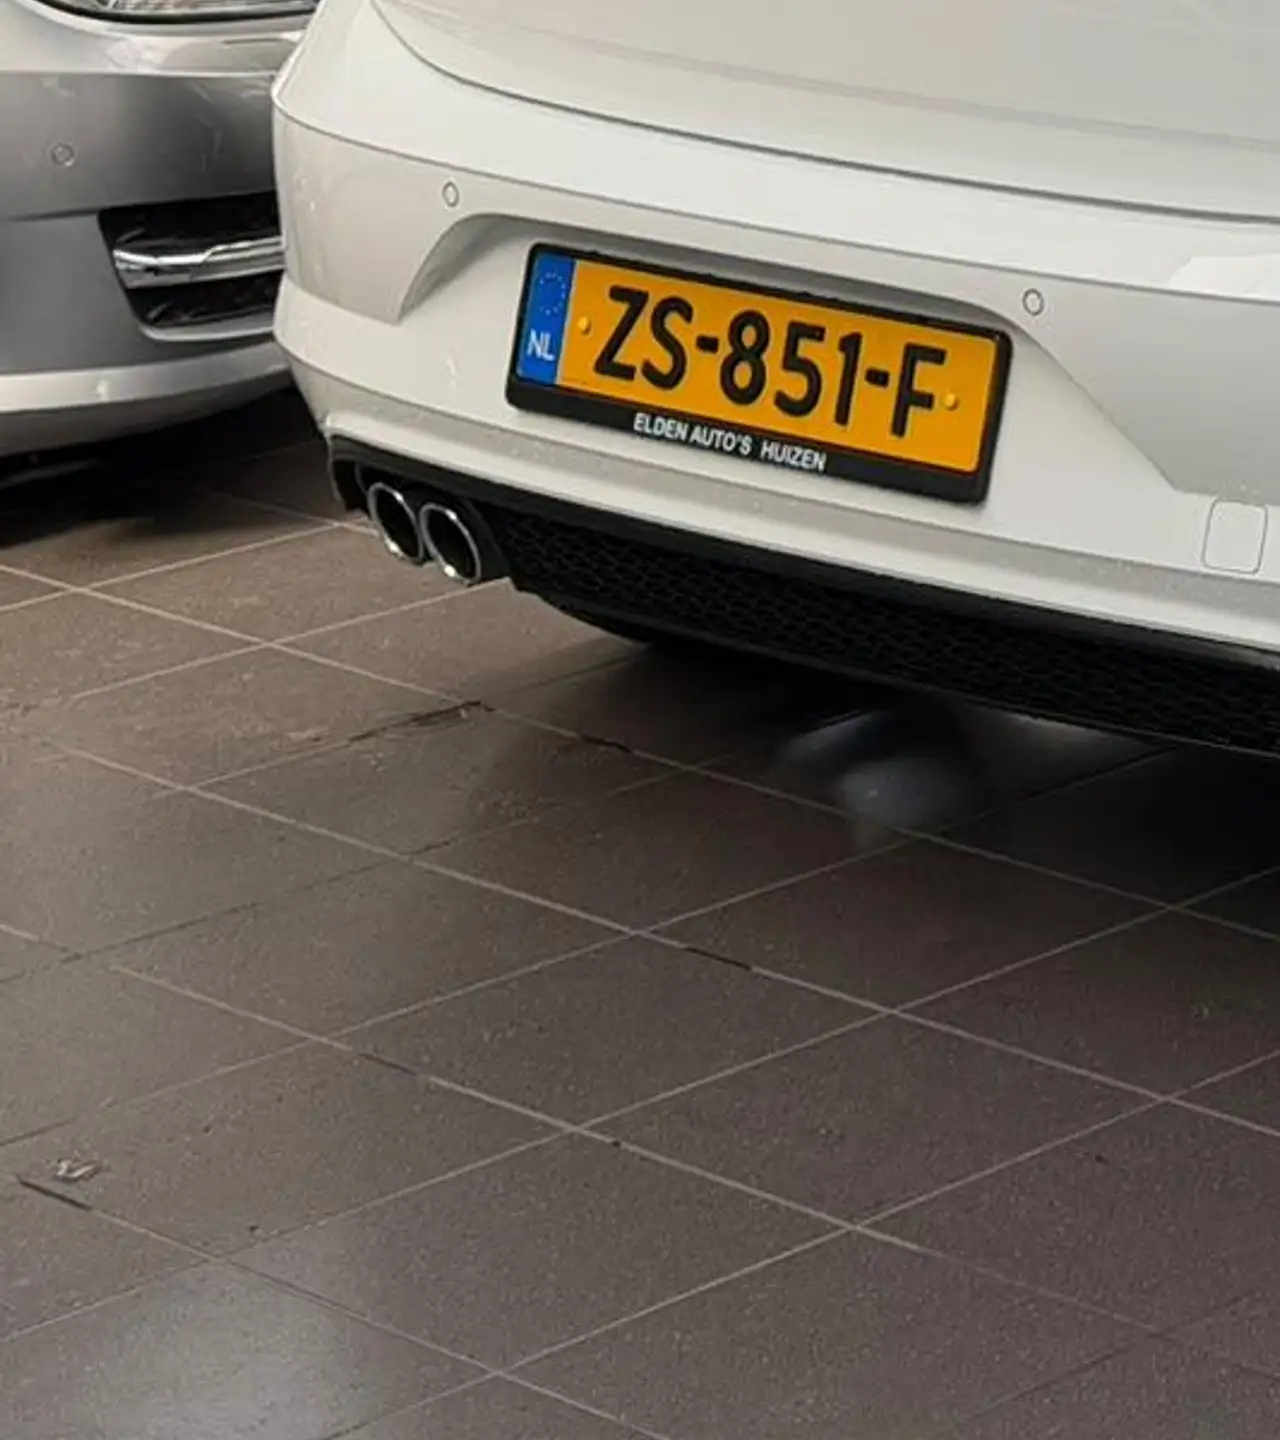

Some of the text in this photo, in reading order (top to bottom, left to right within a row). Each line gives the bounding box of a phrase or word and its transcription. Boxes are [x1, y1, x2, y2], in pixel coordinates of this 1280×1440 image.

[526, 328, 555, 361] NL
[593, 286, 947, 438] ZS-851-F
[632, 412, 827, 473] ELDEN AUTO'S HUIZEN
